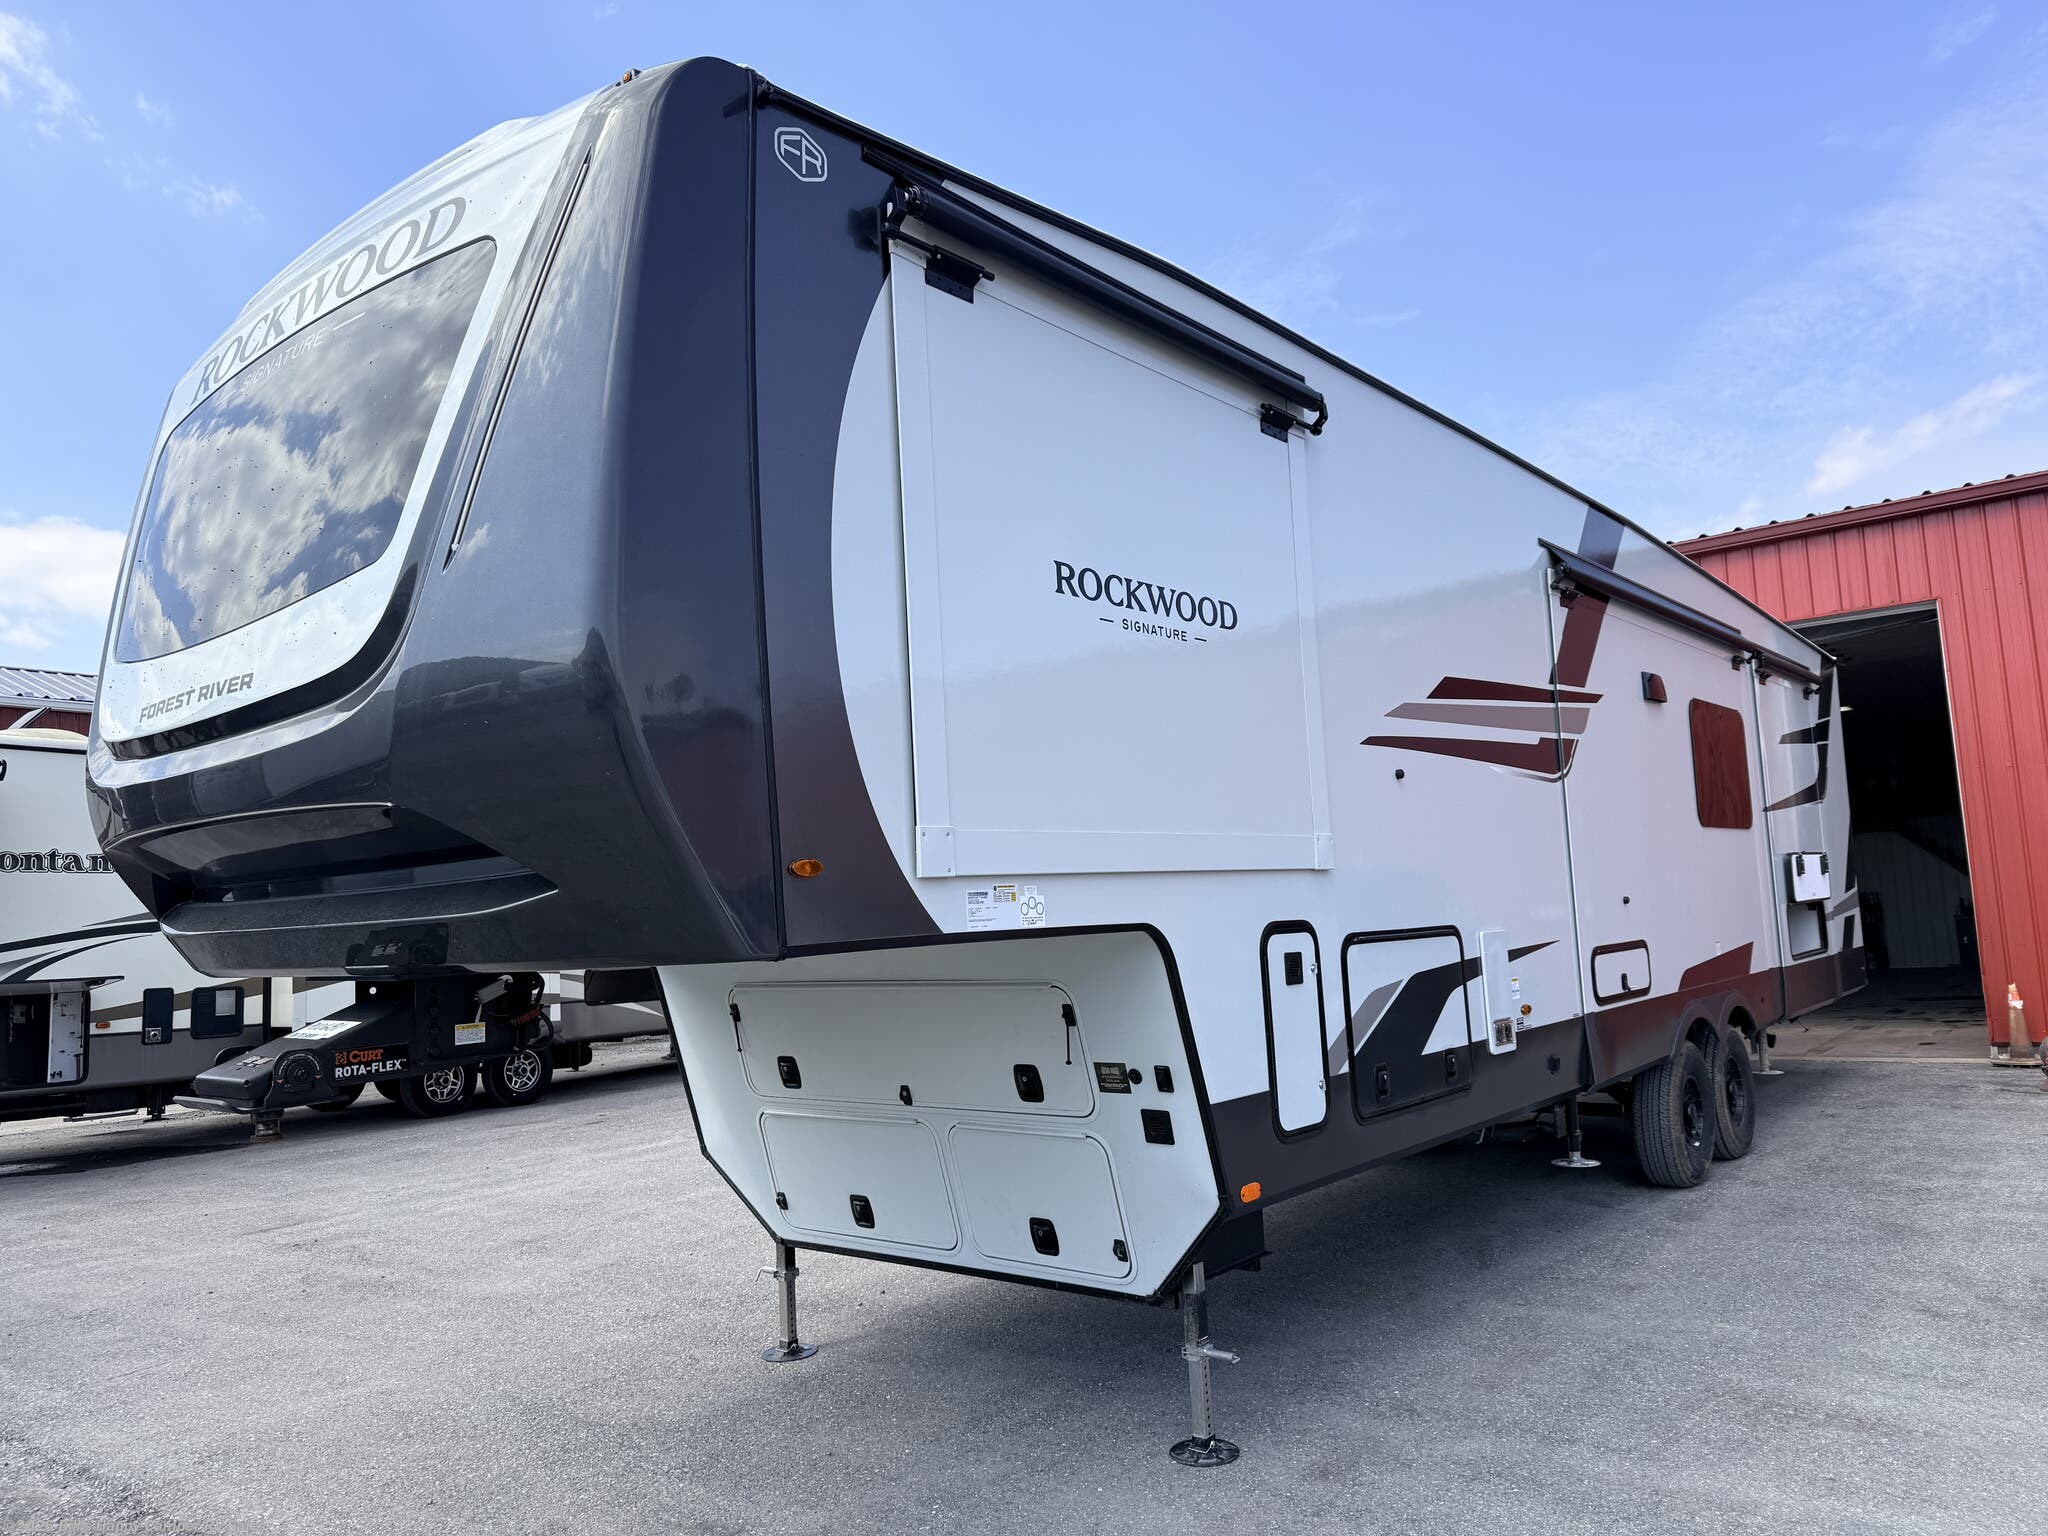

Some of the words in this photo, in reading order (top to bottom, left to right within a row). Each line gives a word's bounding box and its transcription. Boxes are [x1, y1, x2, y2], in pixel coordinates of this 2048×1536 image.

[189, 196, 467, 407] ROCKWOOD
[240, 327, 330, 395] SIGNATURE
[1053, 559, 1239, 631] ROCKWOOD
[1121, 618, 1188, 642] SIGNATURE
[139, 688, 196, 723] FOREST
[197, 672, 254, 703] RIVER
[0, 848, 115, 874] ontan
[349, 1048, 384, 1063] CURT
